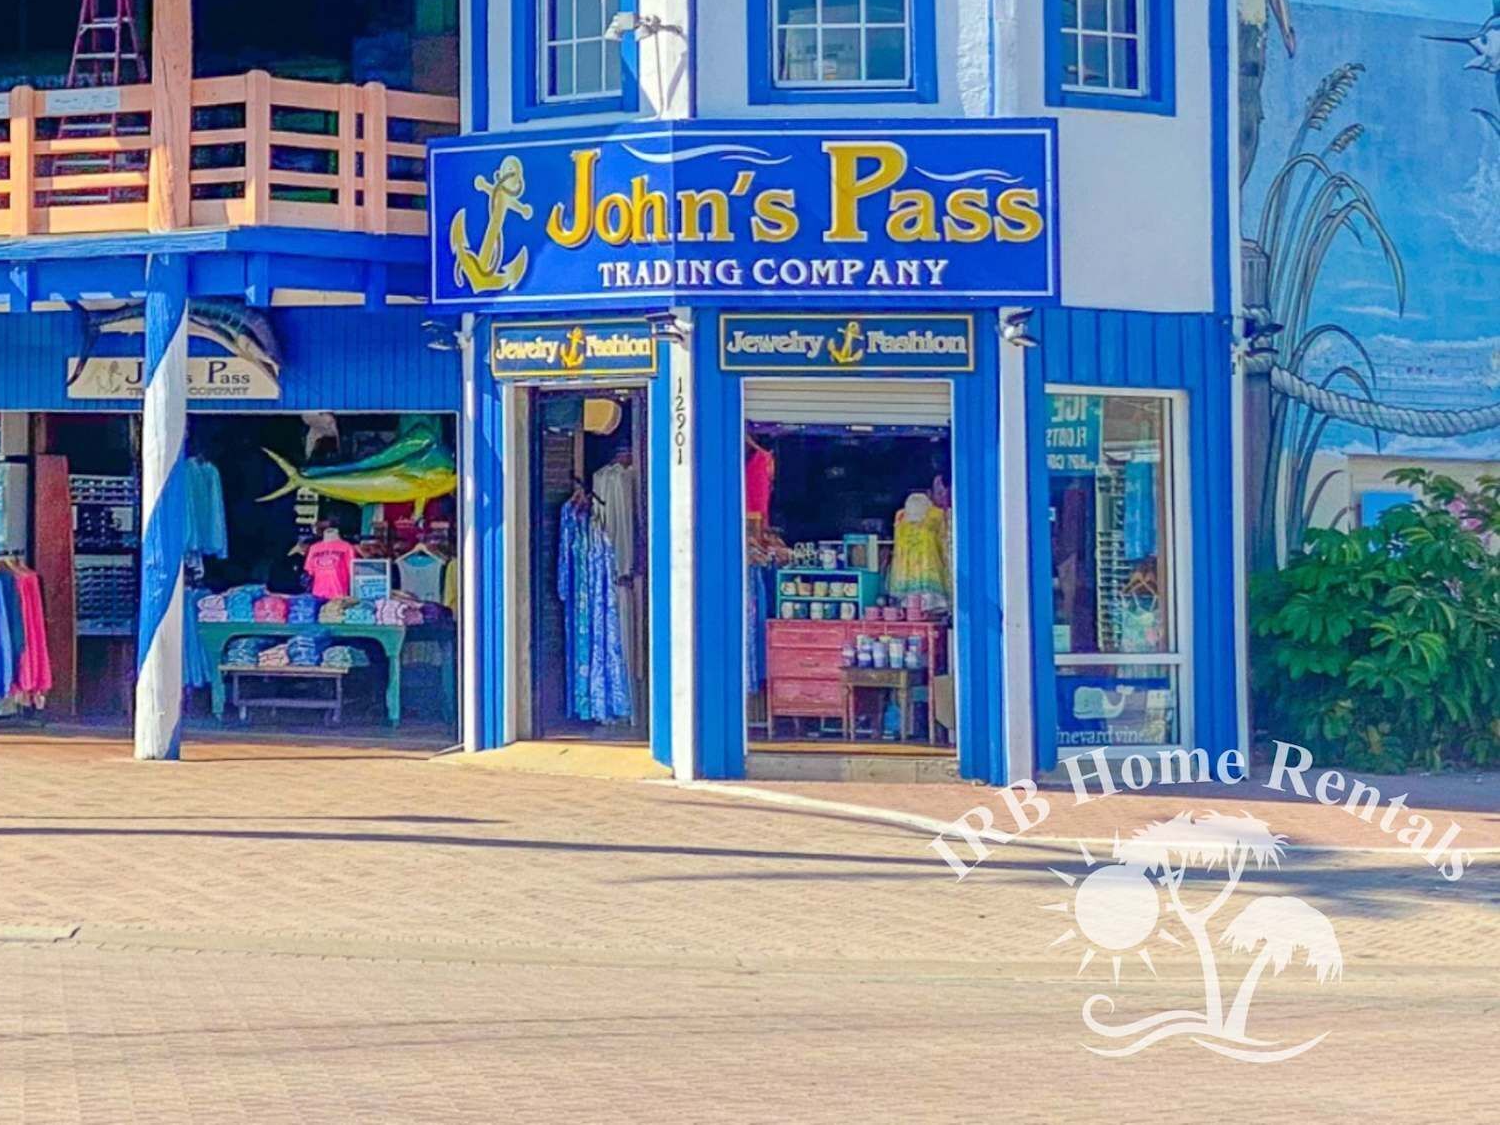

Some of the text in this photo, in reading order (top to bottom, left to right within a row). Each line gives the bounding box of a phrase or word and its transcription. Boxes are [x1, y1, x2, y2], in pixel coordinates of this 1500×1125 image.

[545, 140, 1044, 248] John's Pass
[599, 257, 949, 287] TRADING COMPANY
[495, 334, 651, 363] Jewelry Fashion
[726, 331, 968, 358] Jewelry Fashion
[207, 360, 250, 384] Pass
[674, 376, 686, 466] 12901
